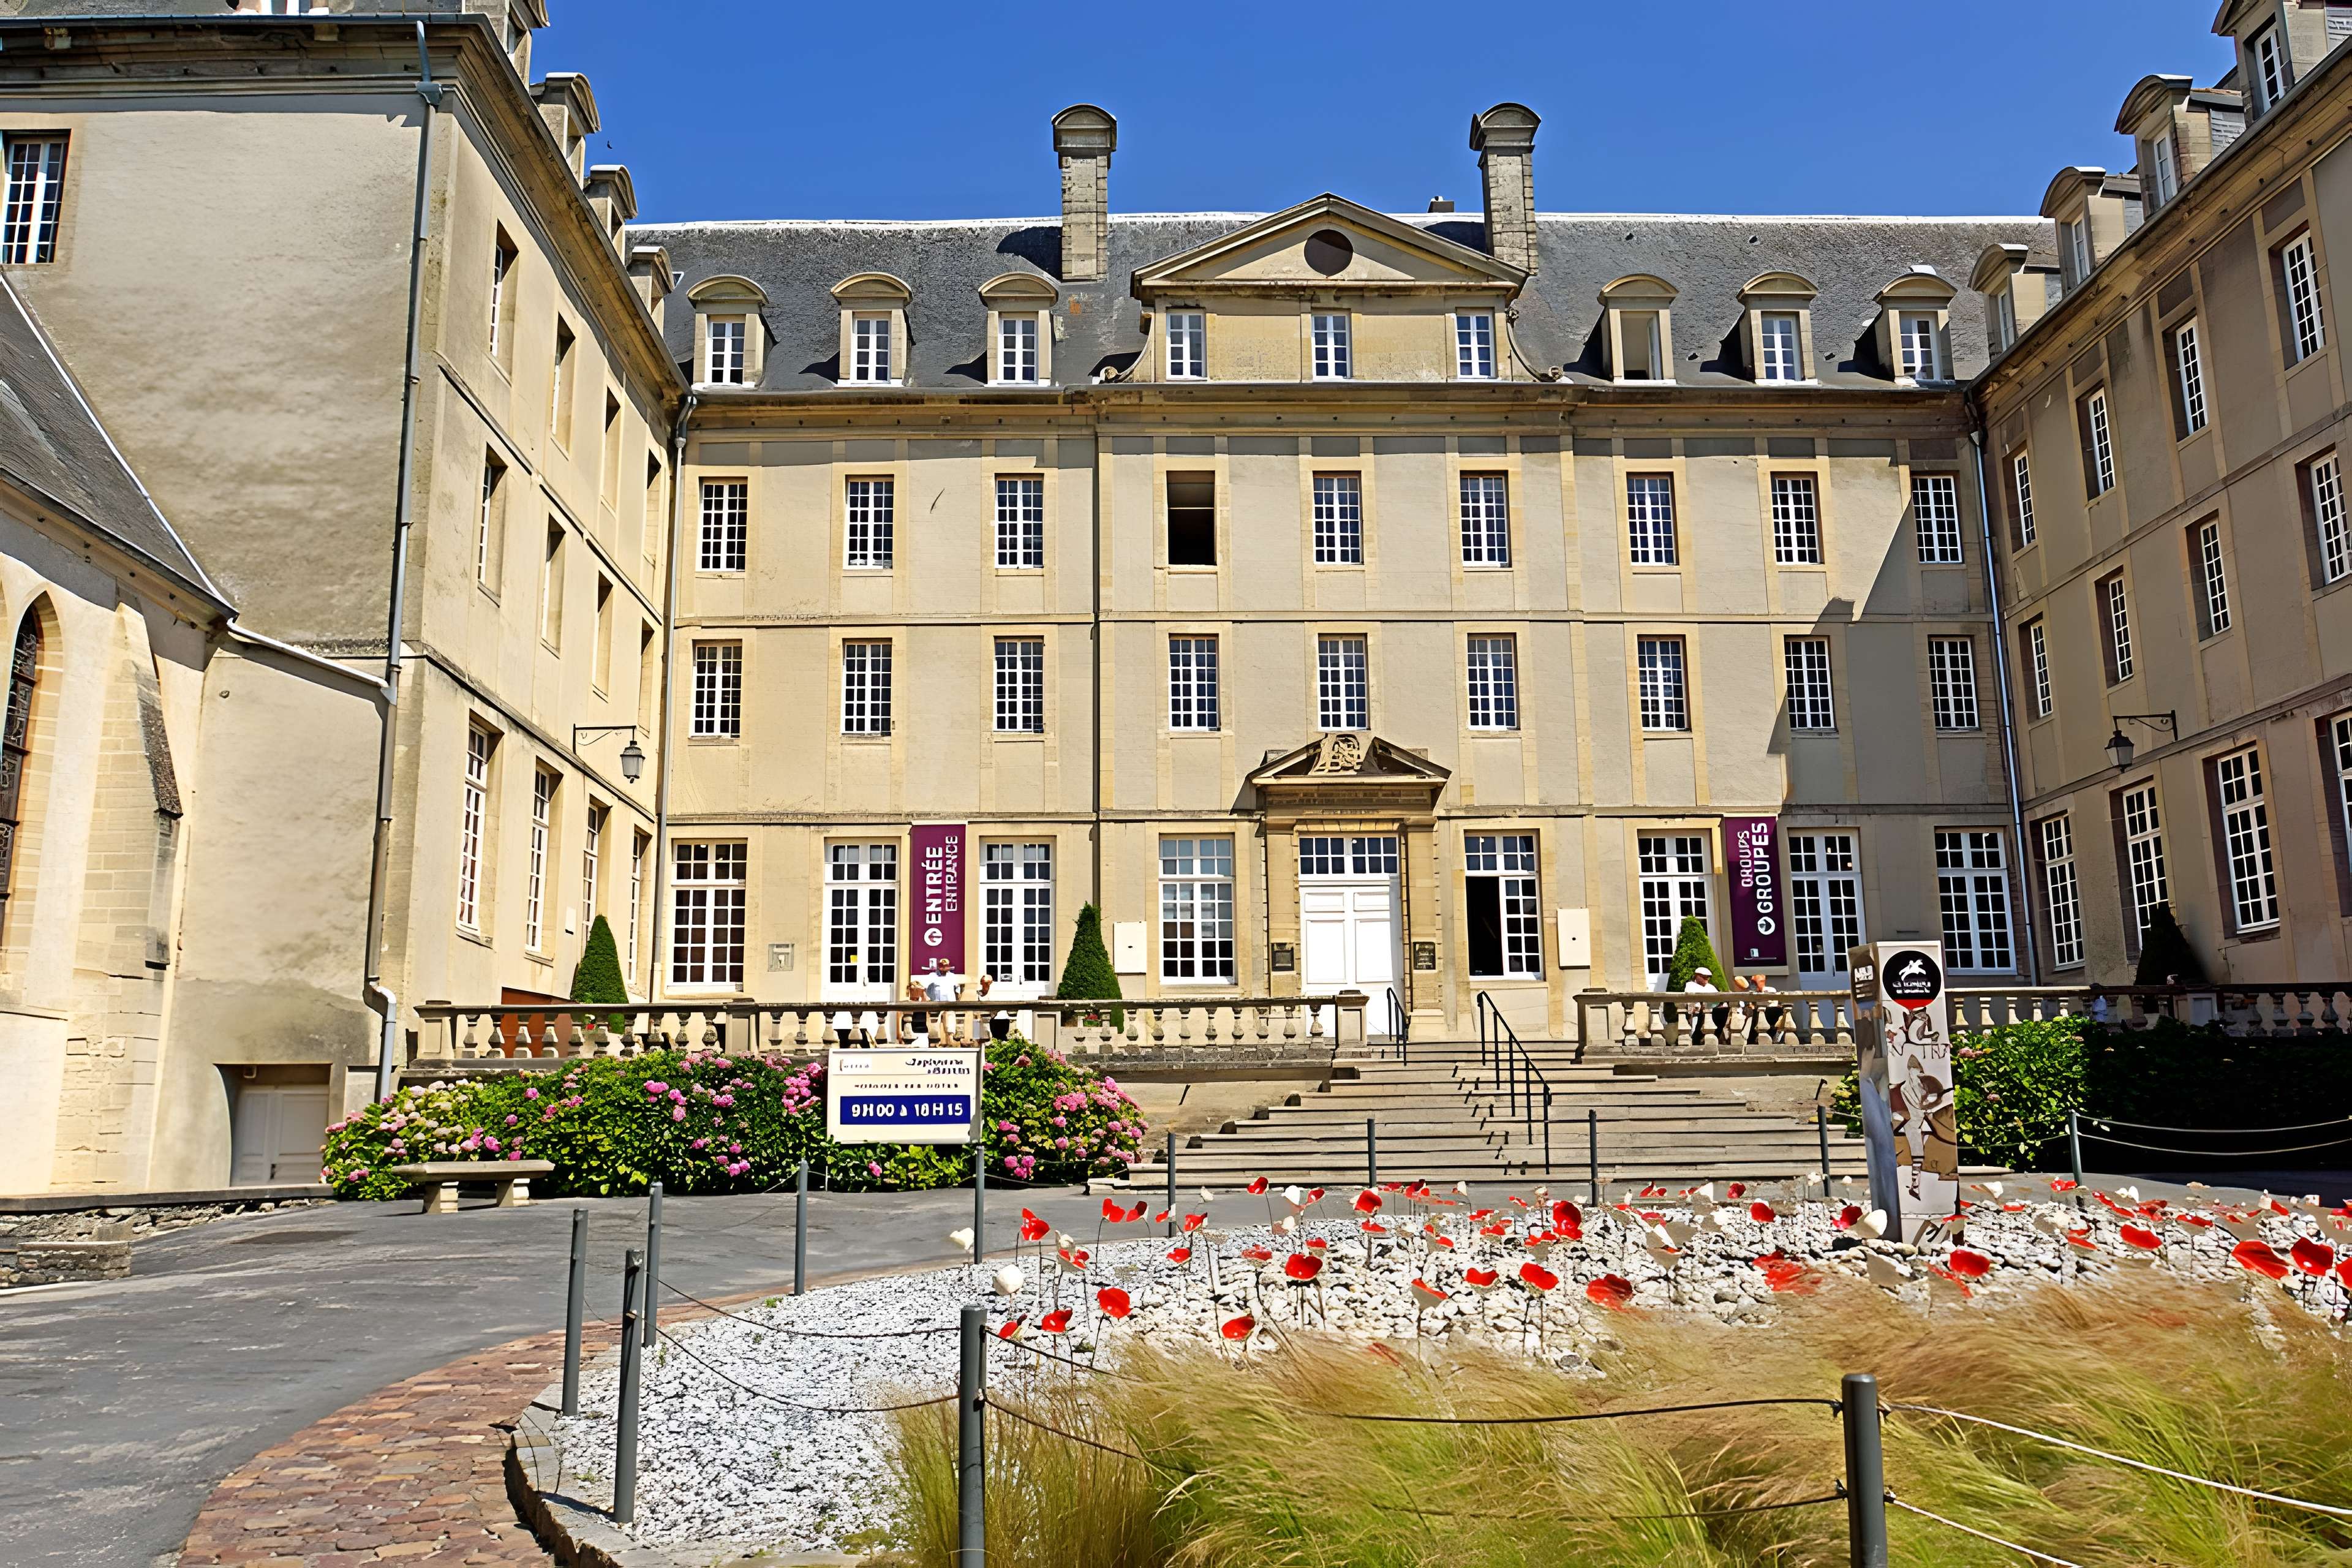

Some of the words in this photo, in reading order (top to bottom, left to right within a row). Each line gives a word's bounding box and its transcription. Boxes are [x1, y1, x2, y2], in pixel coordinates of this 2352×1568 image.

[921, 846, 943, 924] ENTRÉE
[945, 836, 958, 911] ENTRANCE
[1752, 823, 1773, 913] GROUPES
